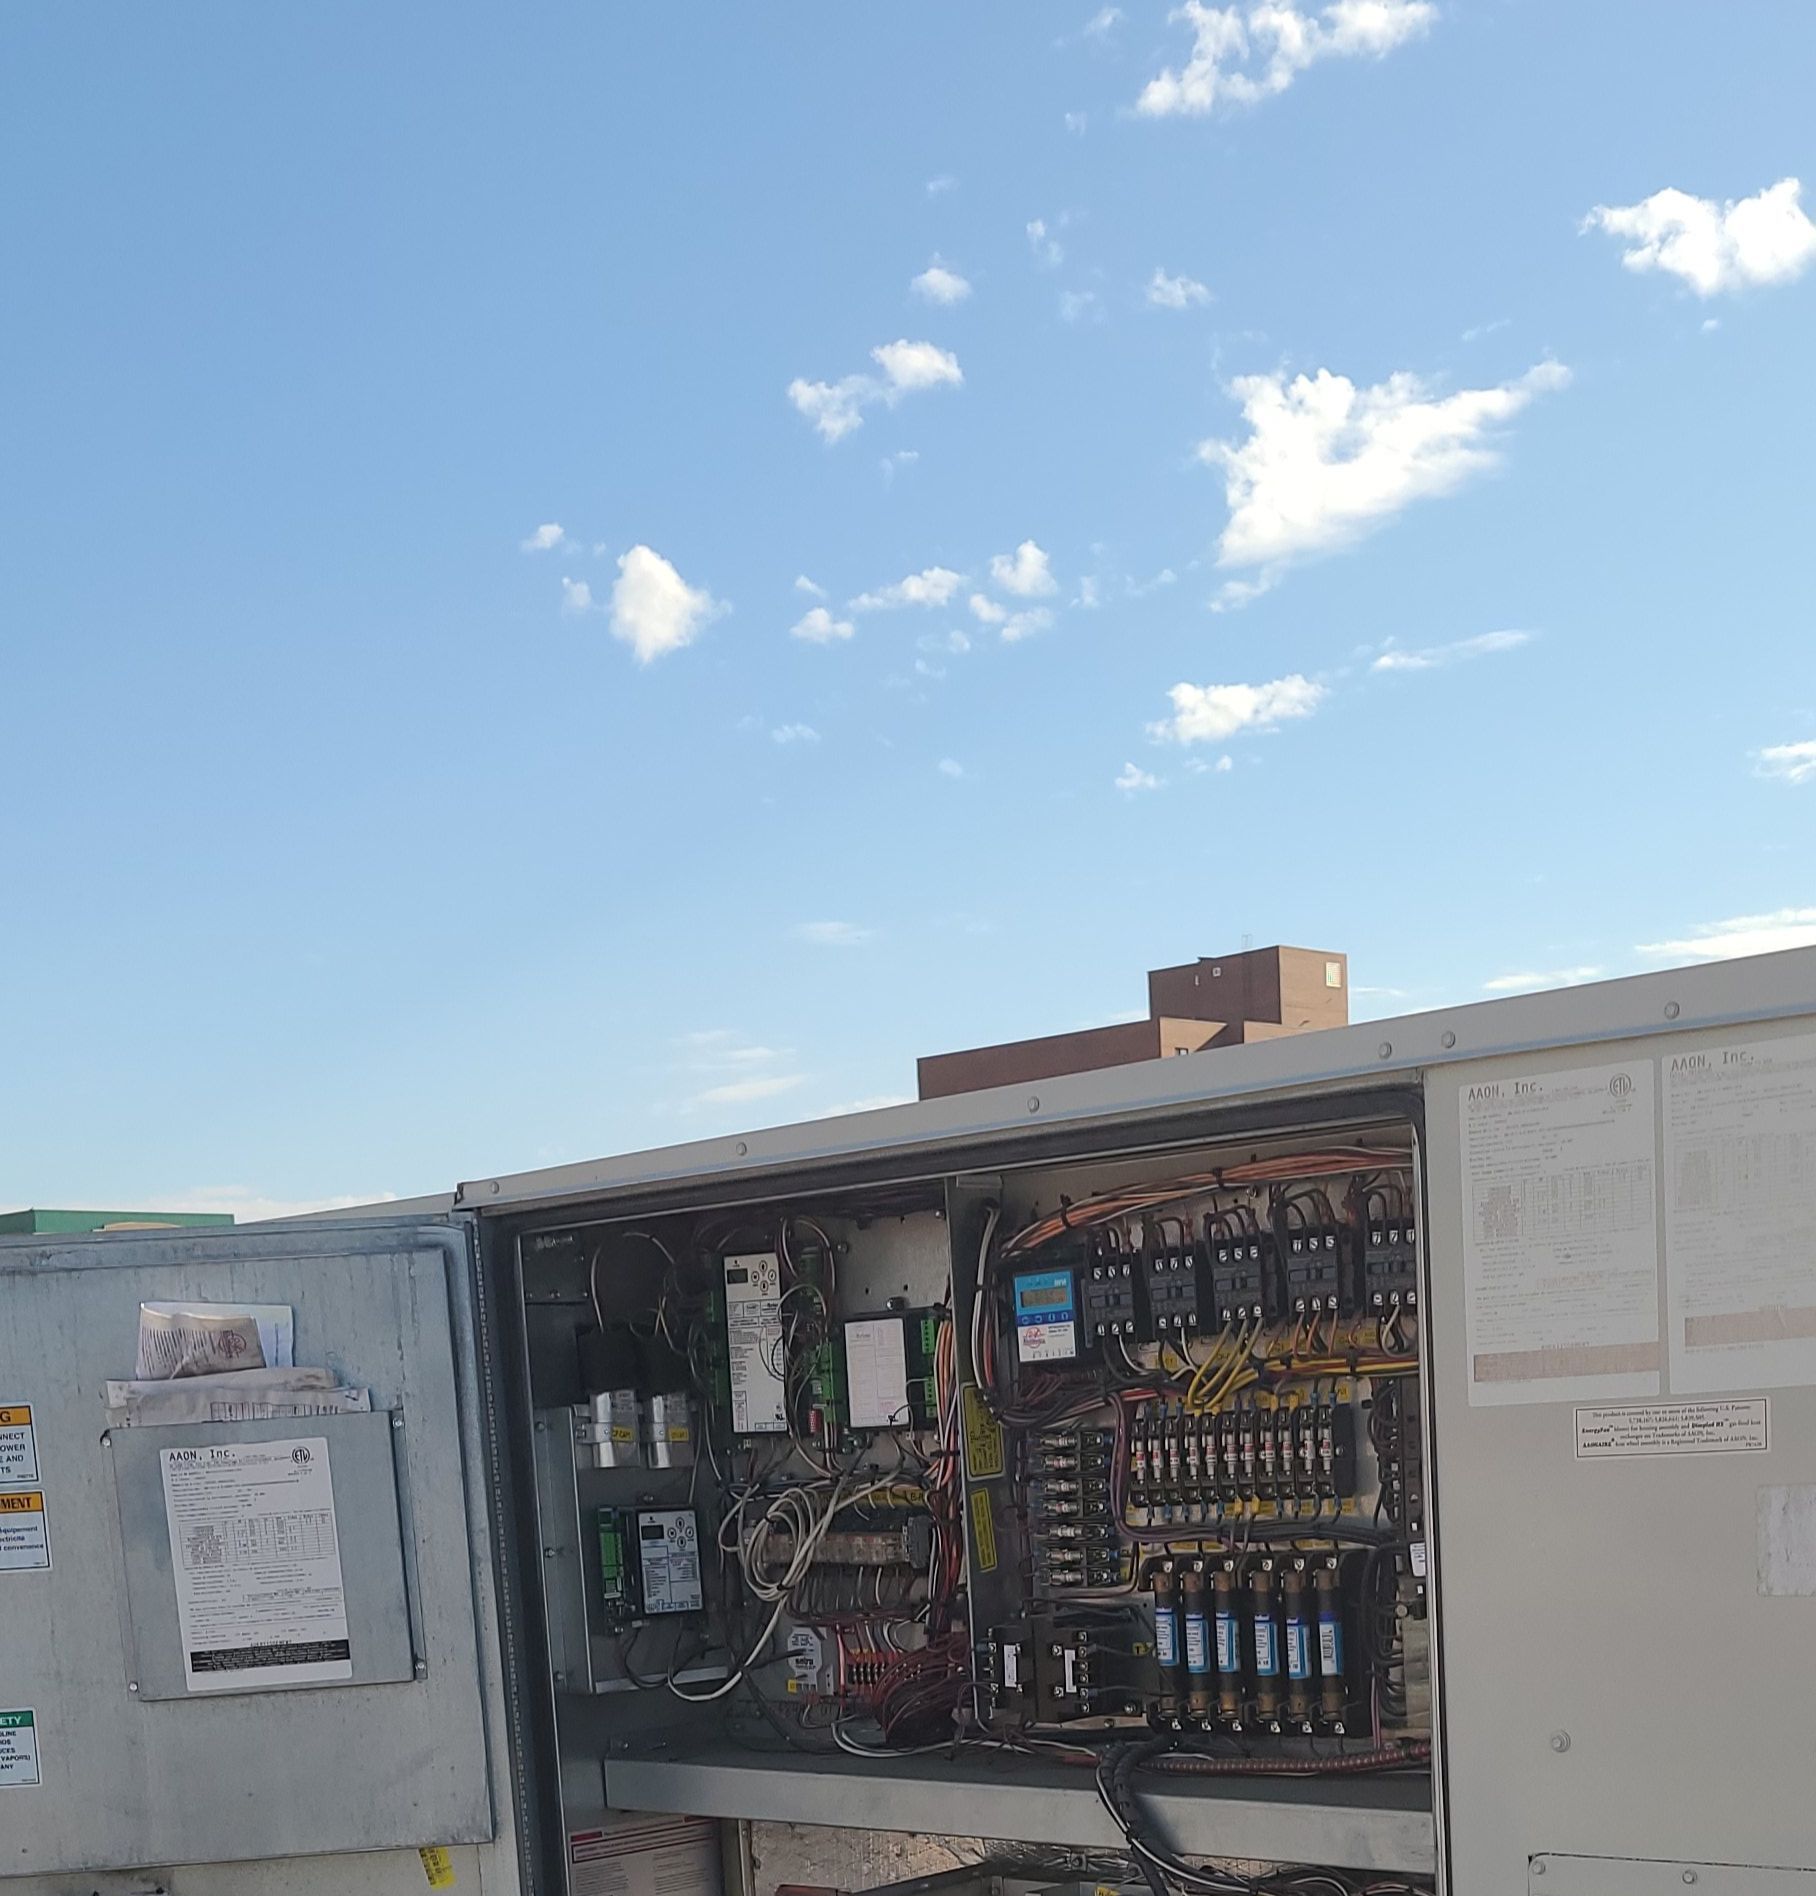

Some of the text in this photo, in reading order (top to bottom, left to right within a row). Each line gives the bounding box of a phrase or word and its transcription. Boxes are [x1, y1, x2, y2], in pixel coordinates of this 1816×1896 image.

[1468, 1081, 1543, 1101] AAON, Inc.
[6, 1454, 24, 1462] AND
[169, 1449, 236, 1461] AAON, Inc.
